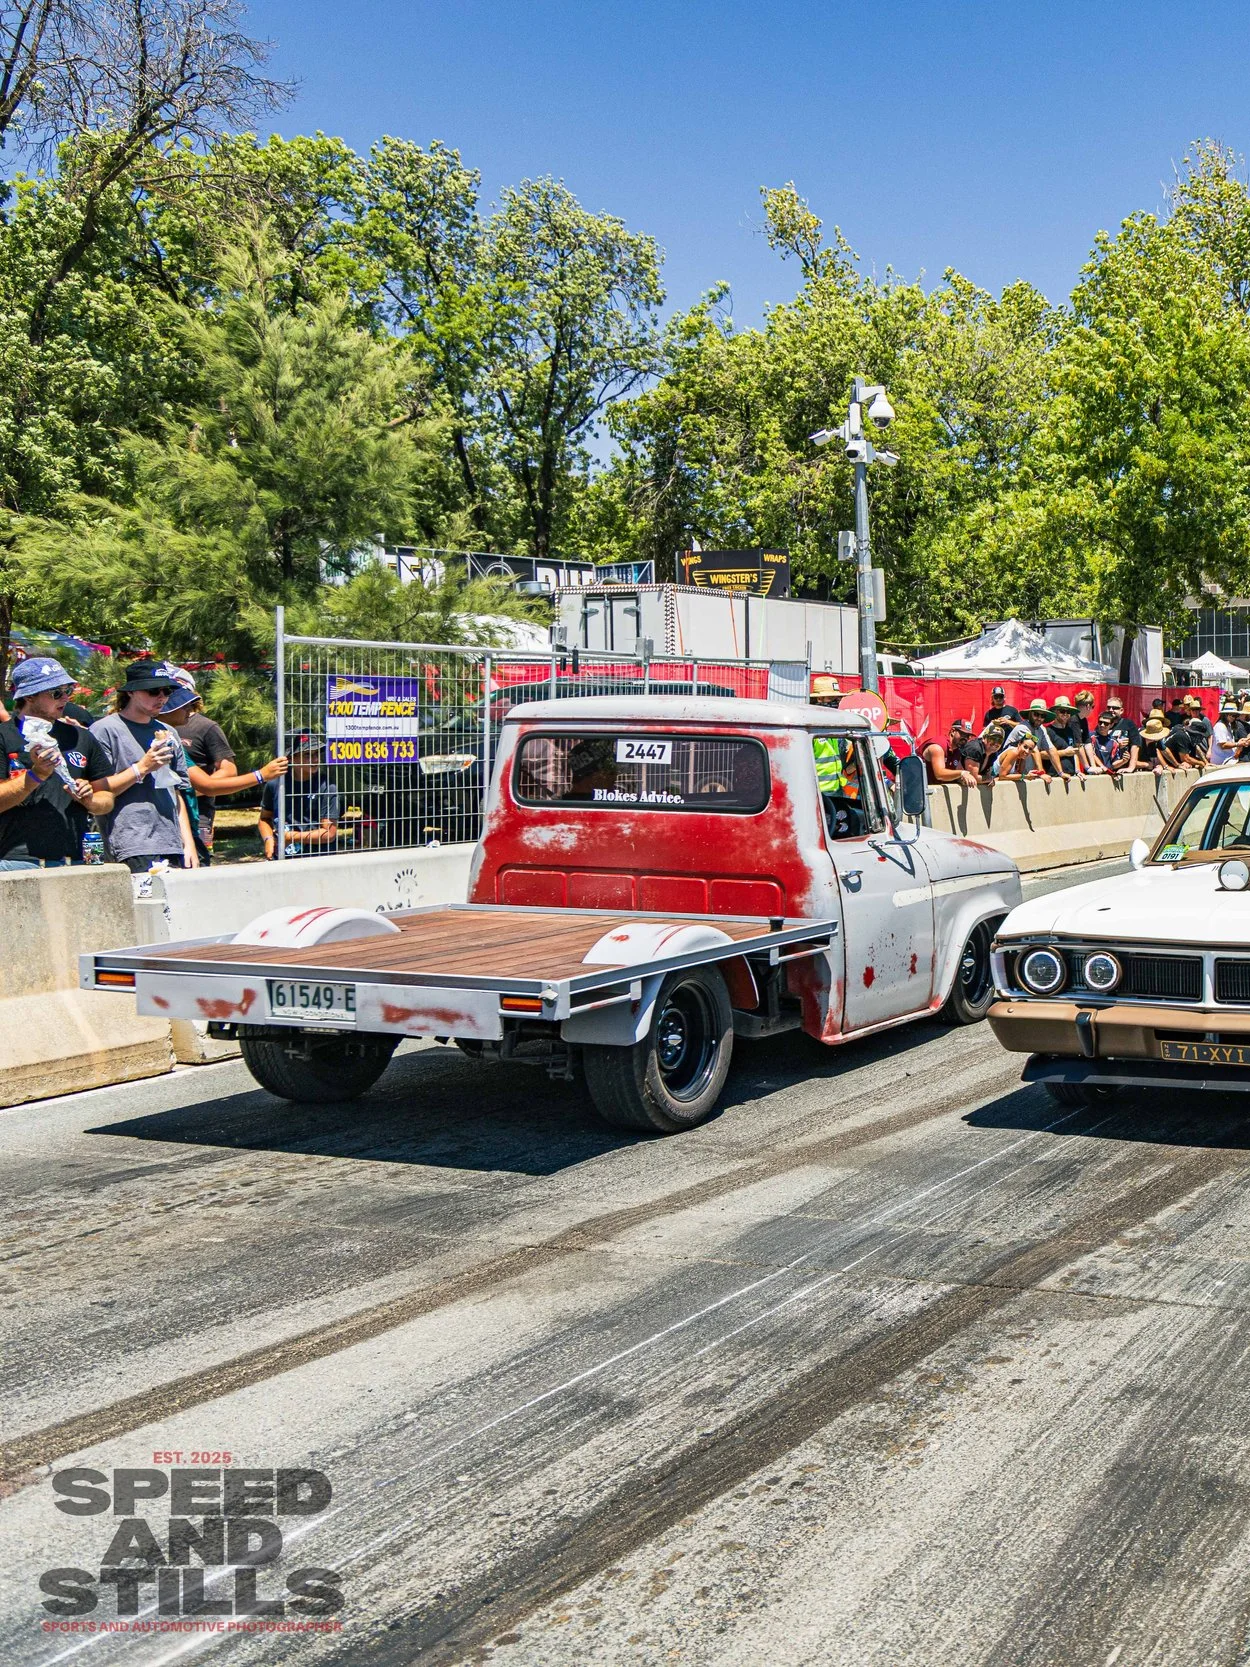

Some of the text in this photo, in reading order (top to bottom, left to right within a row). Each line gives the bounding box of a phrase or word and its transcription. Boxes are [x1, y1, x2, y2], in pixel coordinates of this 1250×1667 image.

[763, 553, 787, 564] WRAPS
[710, 573, 758, 585] WINGSTER'S
[329, 701, 416, 716] 1300TEMPFENCE
[329, 740, 414, 760] 1300 836 733
[625, 742, 667, 760] 2447
[593, 788, 685, 804] Blokes Advice.
